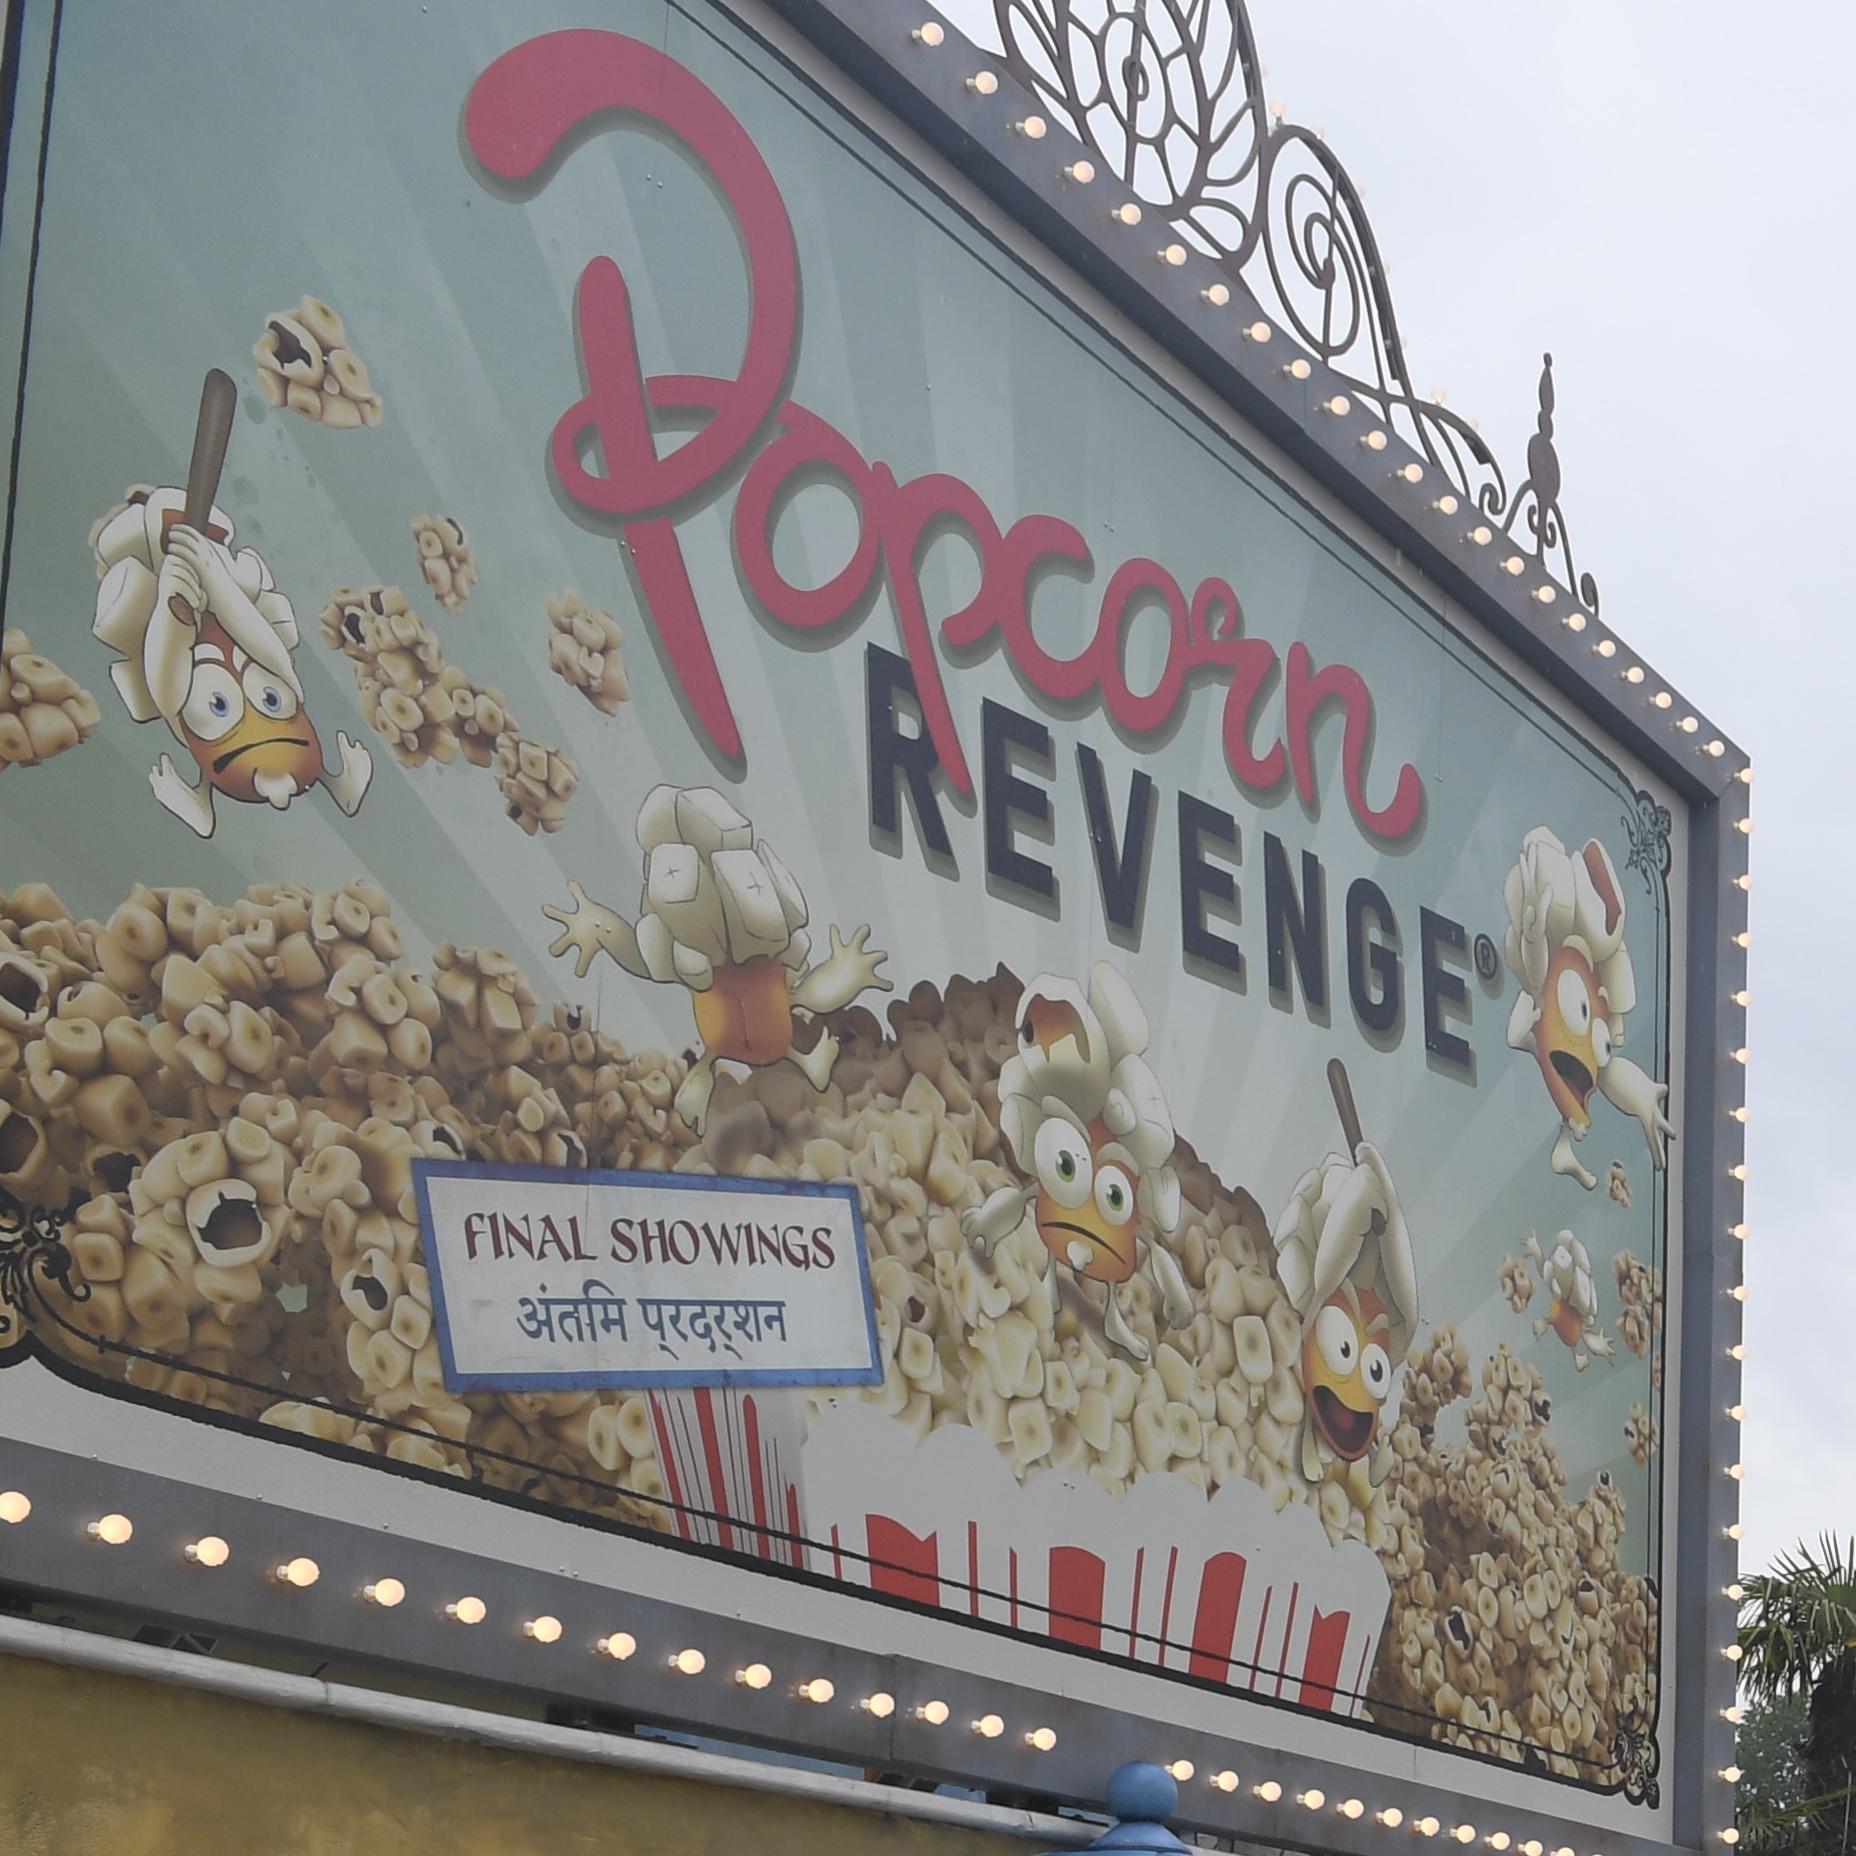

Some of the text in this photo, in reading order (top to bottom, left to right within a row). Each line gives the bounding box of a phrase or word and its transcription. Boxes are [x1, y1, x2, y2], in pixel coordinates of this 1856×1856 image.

[464, 26, 1423, 838] Popcorn
[463, 1211, 836, 1271] FINAL SHOWINGS
